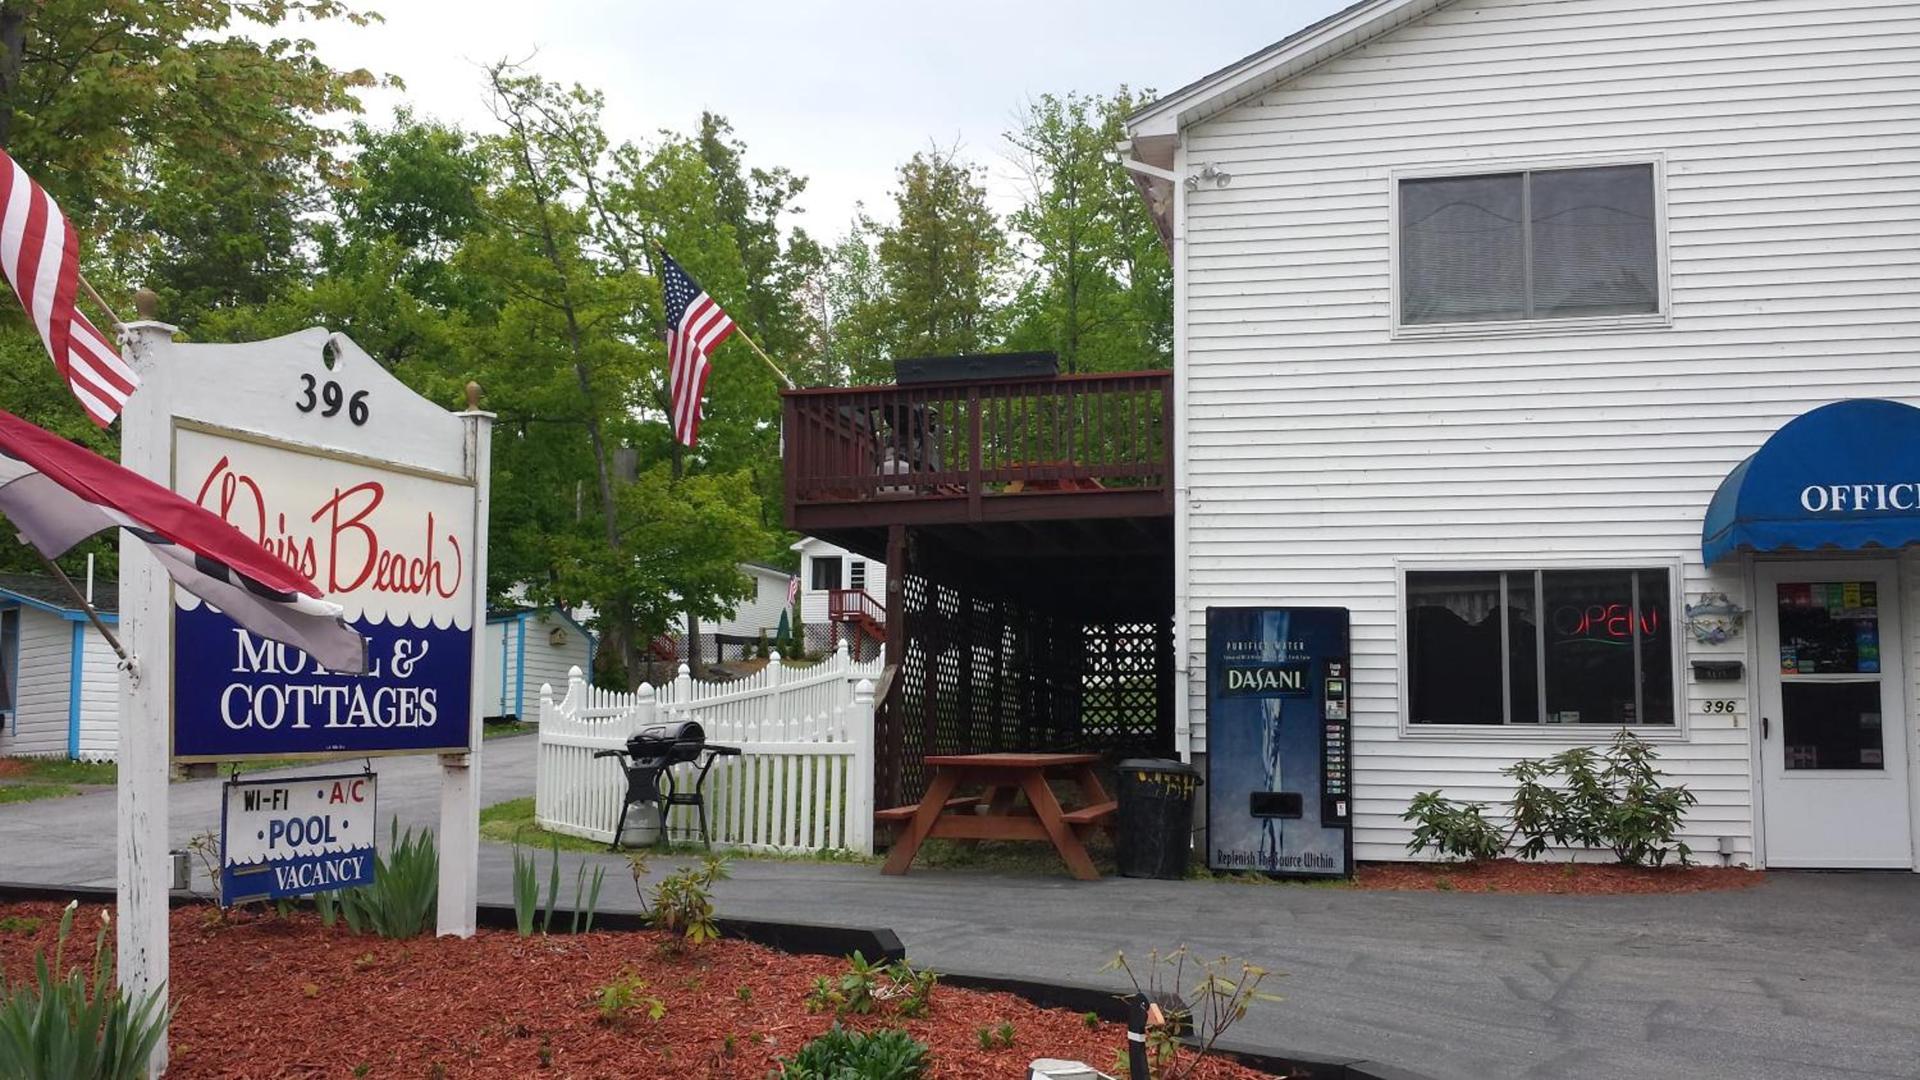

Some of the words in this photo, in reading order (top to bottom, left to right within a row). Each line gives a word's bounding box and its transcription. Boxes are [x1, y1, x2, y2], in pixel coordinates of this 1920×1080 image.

[296, 373, 370, 426] 396
[312, 482, 462, 598] Beach
[1553, 603, 1658, 636] OPEN
[391, 638, 430, 678] &
[1274, 641, 1304, 652] WATER
[1228, 668, 1300, 692] DASANI
[220, 683, 437, 730] COTTAGES
[1703, 700, 1736, 713] 396
[244, 789, 289, 811] WI-FI
[329, 780, 364, 804] A/C
[269, 815, 336, 849] POOL
[275, 856, 364, 891] VACANCY
[1217, 849, 1256, 867] Replenish
